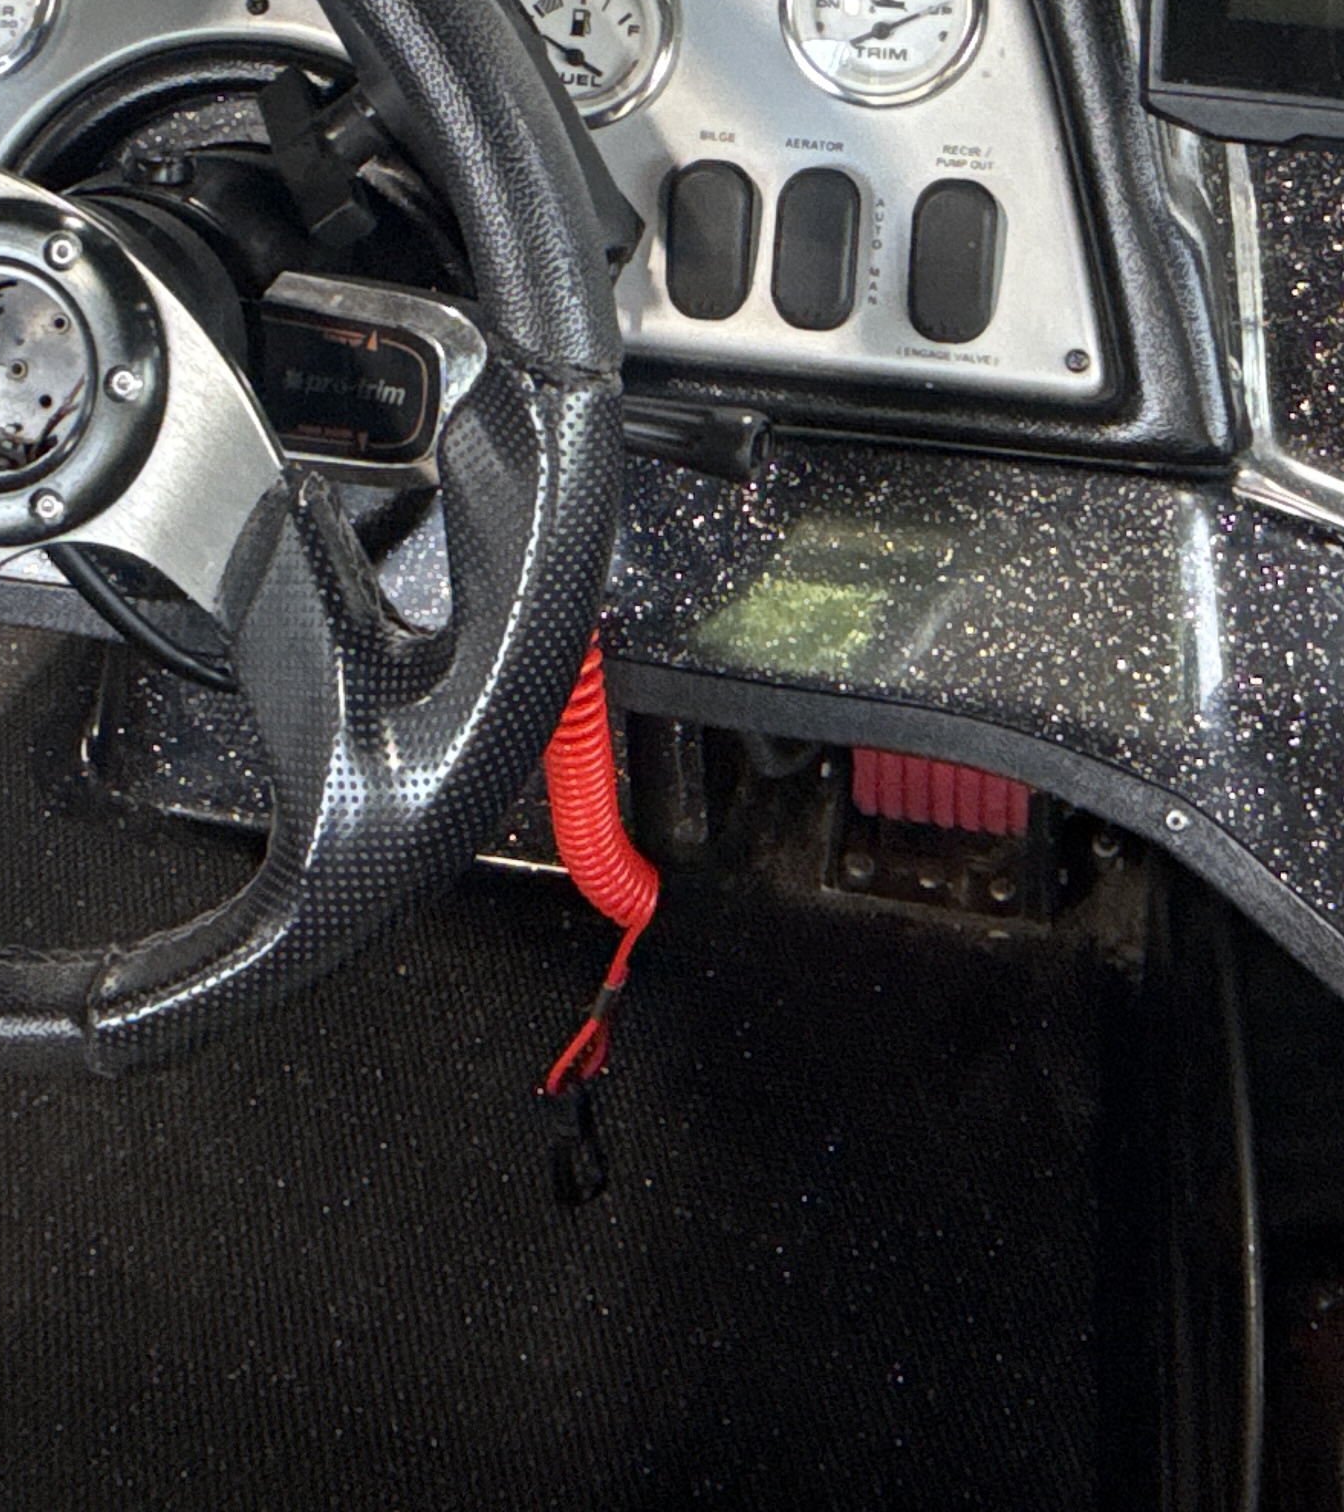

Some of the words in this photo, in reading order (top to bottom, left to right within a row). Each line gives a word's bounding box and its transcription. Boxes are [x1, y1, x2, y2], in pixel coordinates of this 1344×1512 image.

[627, 24, 640, 36] F
[856, 46, 908, 61] TRIM
[560, 72, 602, 88] UEL
[699, 130, 736, 142] BILGE
[785, 138, 844, 152] AERATOR
[970, 160, 994, 170] OUT
